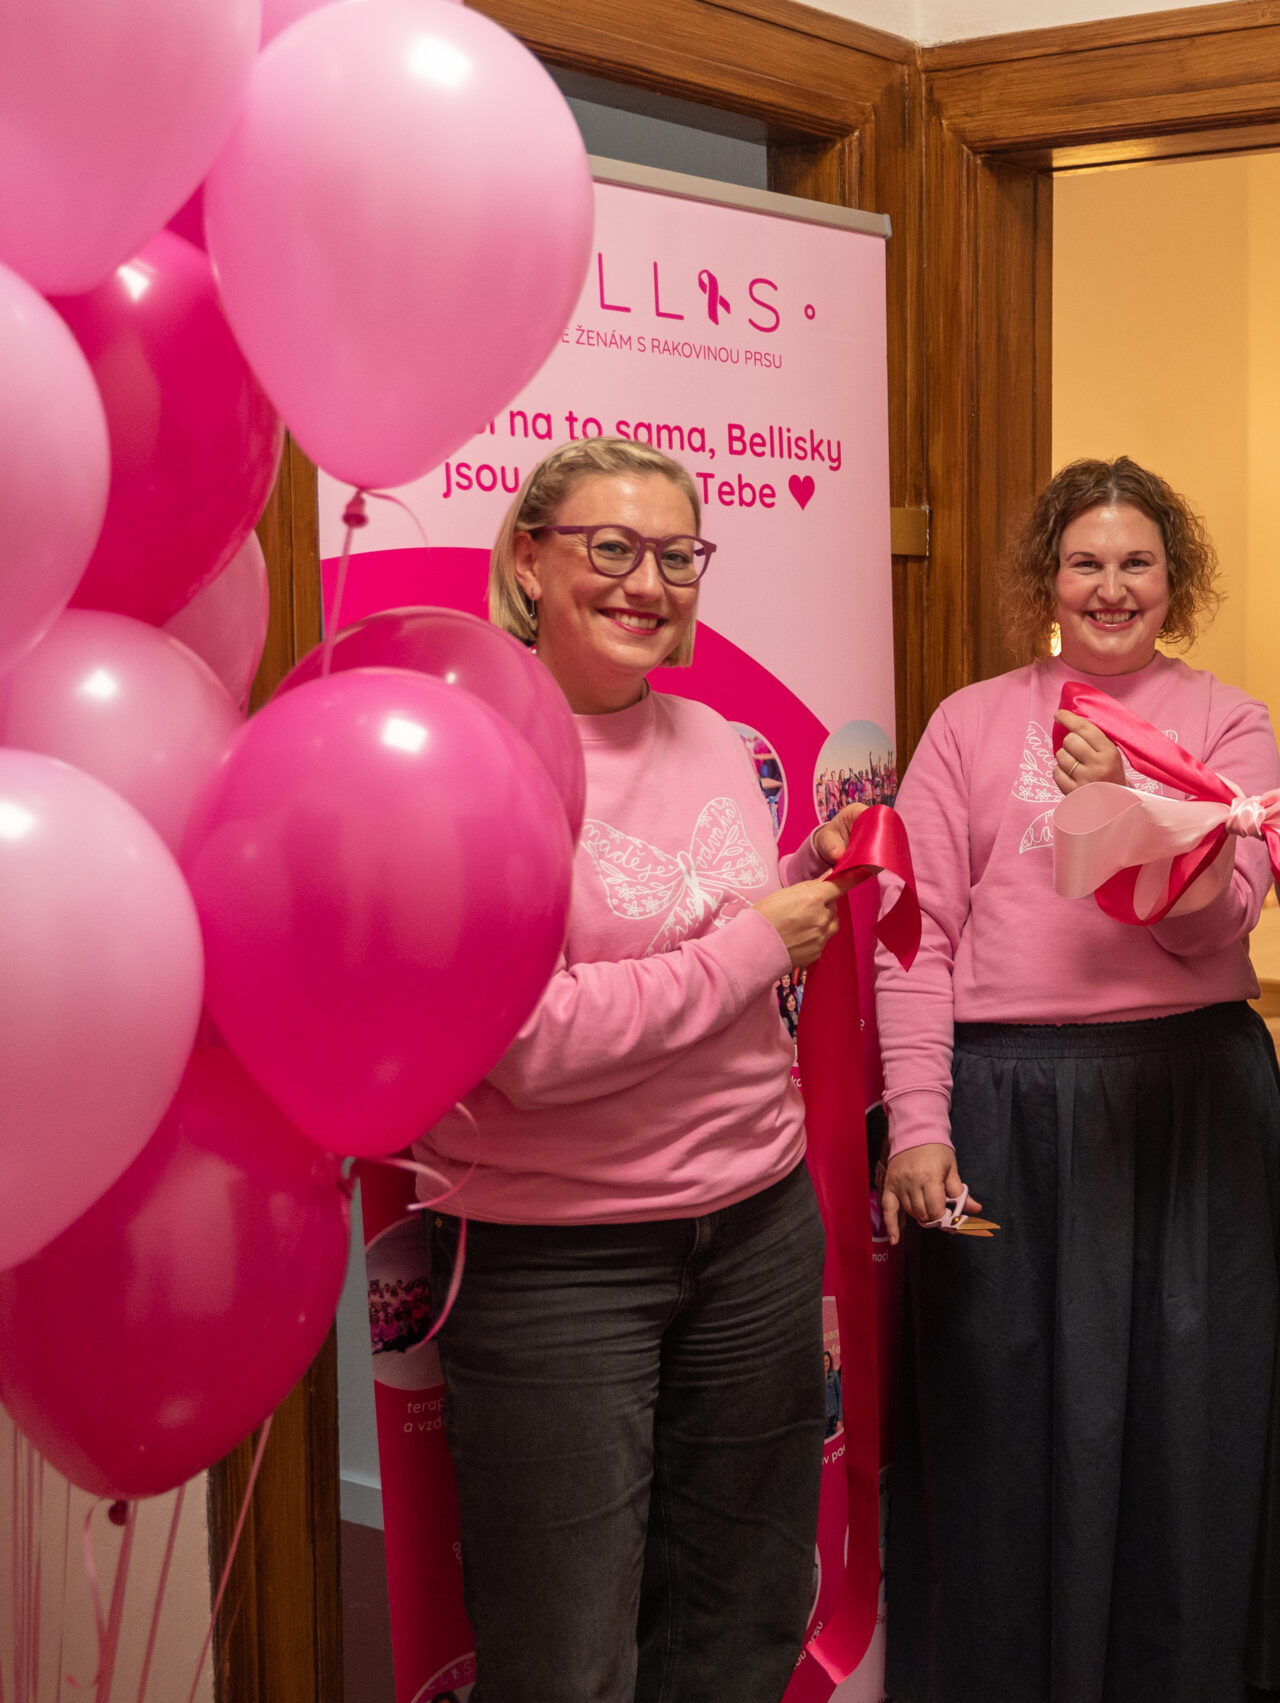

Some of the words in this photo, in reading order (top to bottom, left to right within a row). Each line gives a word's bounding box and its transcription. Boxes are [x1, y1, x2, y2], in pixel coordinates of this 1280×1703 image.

[575, 325, 632, 351] ŽENÁM
[637, 336, 646, 352] S
[651, 338, 739, 364] RAKOVINOU
[744, 350, 782, 369] PRSU
[509, 410, 552, 440] na
[565, 410, 602, 441] to
[616, 420, 716, 460] sama,
[727, 423, 842, 472] Bellisky
[442, 461, 520, 499] jsou
[696, 472, 777, 509] Tebe
